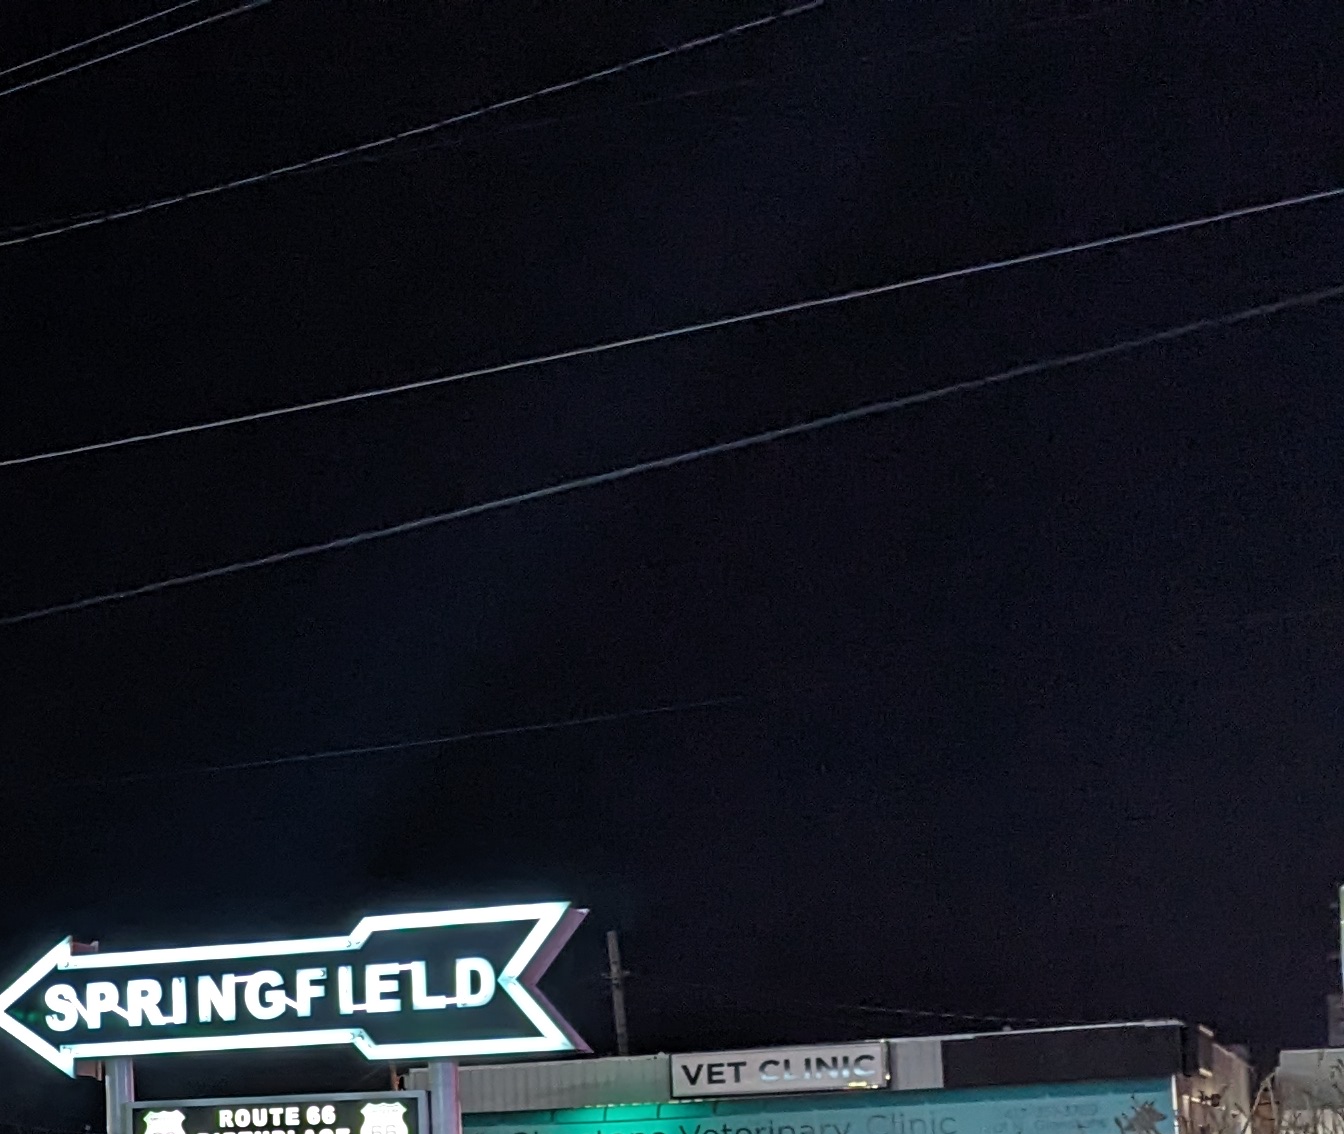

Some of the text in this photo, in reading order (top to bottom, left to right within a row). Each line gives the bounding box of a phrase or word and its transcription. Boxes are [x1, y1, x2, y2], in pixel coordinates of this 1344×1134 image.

[44, 956, 496, 1032] SPRINGFIELD
[681, 1054, 876, 1086] VET CLINIC
[218, 1104, 337, 1128] ROUTE 66
